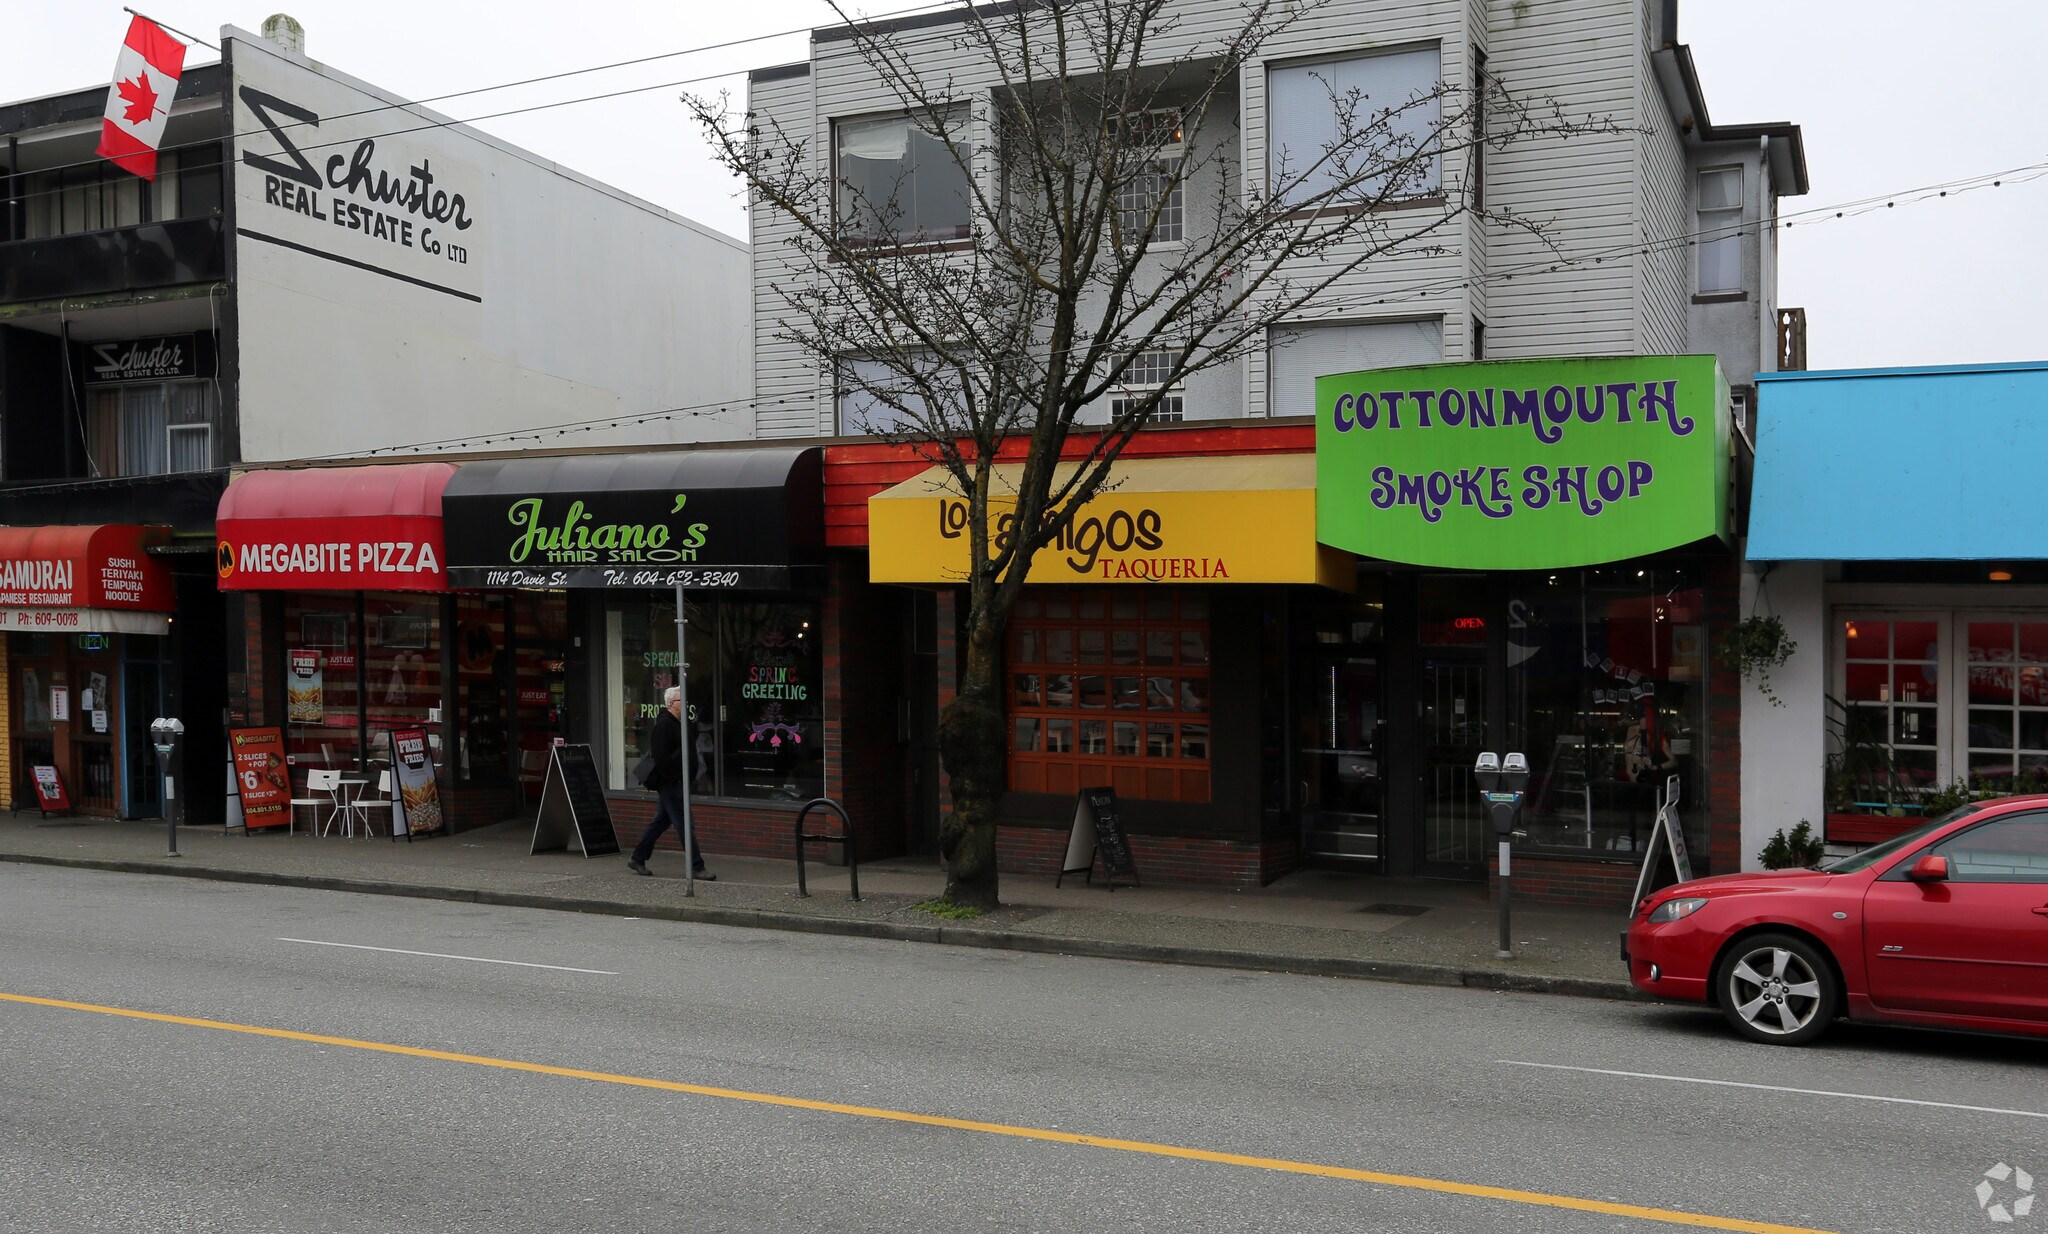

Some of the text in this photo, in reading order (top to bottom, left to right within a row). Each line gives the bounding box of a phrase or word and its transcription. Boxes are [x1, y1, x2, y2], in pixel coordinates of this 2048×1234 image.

[239, 84, 472, 231] Schuster
[265, 174, 327, 221] REAL
[333, 198, 413, 247] ESTATE
[447, 243, 468, 264] LTD
[92, 338, 183, 373] Schuster
[101, 371, 120, 379] REAL
[123, 369, 151, 378] ESTATE
[1369, 460, 1655, 523] SMOKE SHOP
[940, 499, 971, 538] Lo
[508, 493, 709, 563] Juliano's
[239, 542, 351, 573] MEGABITE
[358, 542, 440, 574] PIZZA
[547, 549, 697, 563] HAIR SALON
[108, 557, 136, 569] SUSHI
[1097, 557, 1230, 582] TAQUERIA
[101, 568, 143, 580] TERIYAKI
[486, 570, 509, 586] 1114
[512, 570, 546, 586] Davie
[548, 570, 568, 586] St.
[603, 569, 626, 586] Tel:
[101, 579, 144, 592] TEMPURA
[0, 592, 73, 604] PANESE RESTAURANT
[105, 590, 140, 602] NOODLE
[18, 612, 33, 625] Ph:
[35, 612, 78, 626] 609-0078
[1454, 617, 1485, 629] OPEN
[79, 634, 109, 649] OPEN
[293, 657, 315, 667] FREE
[329, 656, 354, 664] JUST EAT
[296, 667, 314, 675] FRIES
[742, 682, 808, 701] GREETING
[245, 734, 276, 743] MEGABITE
[398, 738, 424, 754] FREE
[238, 752, 268, 761] 2 SLICES
[404, 753, 425, 764] FRIES
[253, 760, 267, 768] POP
